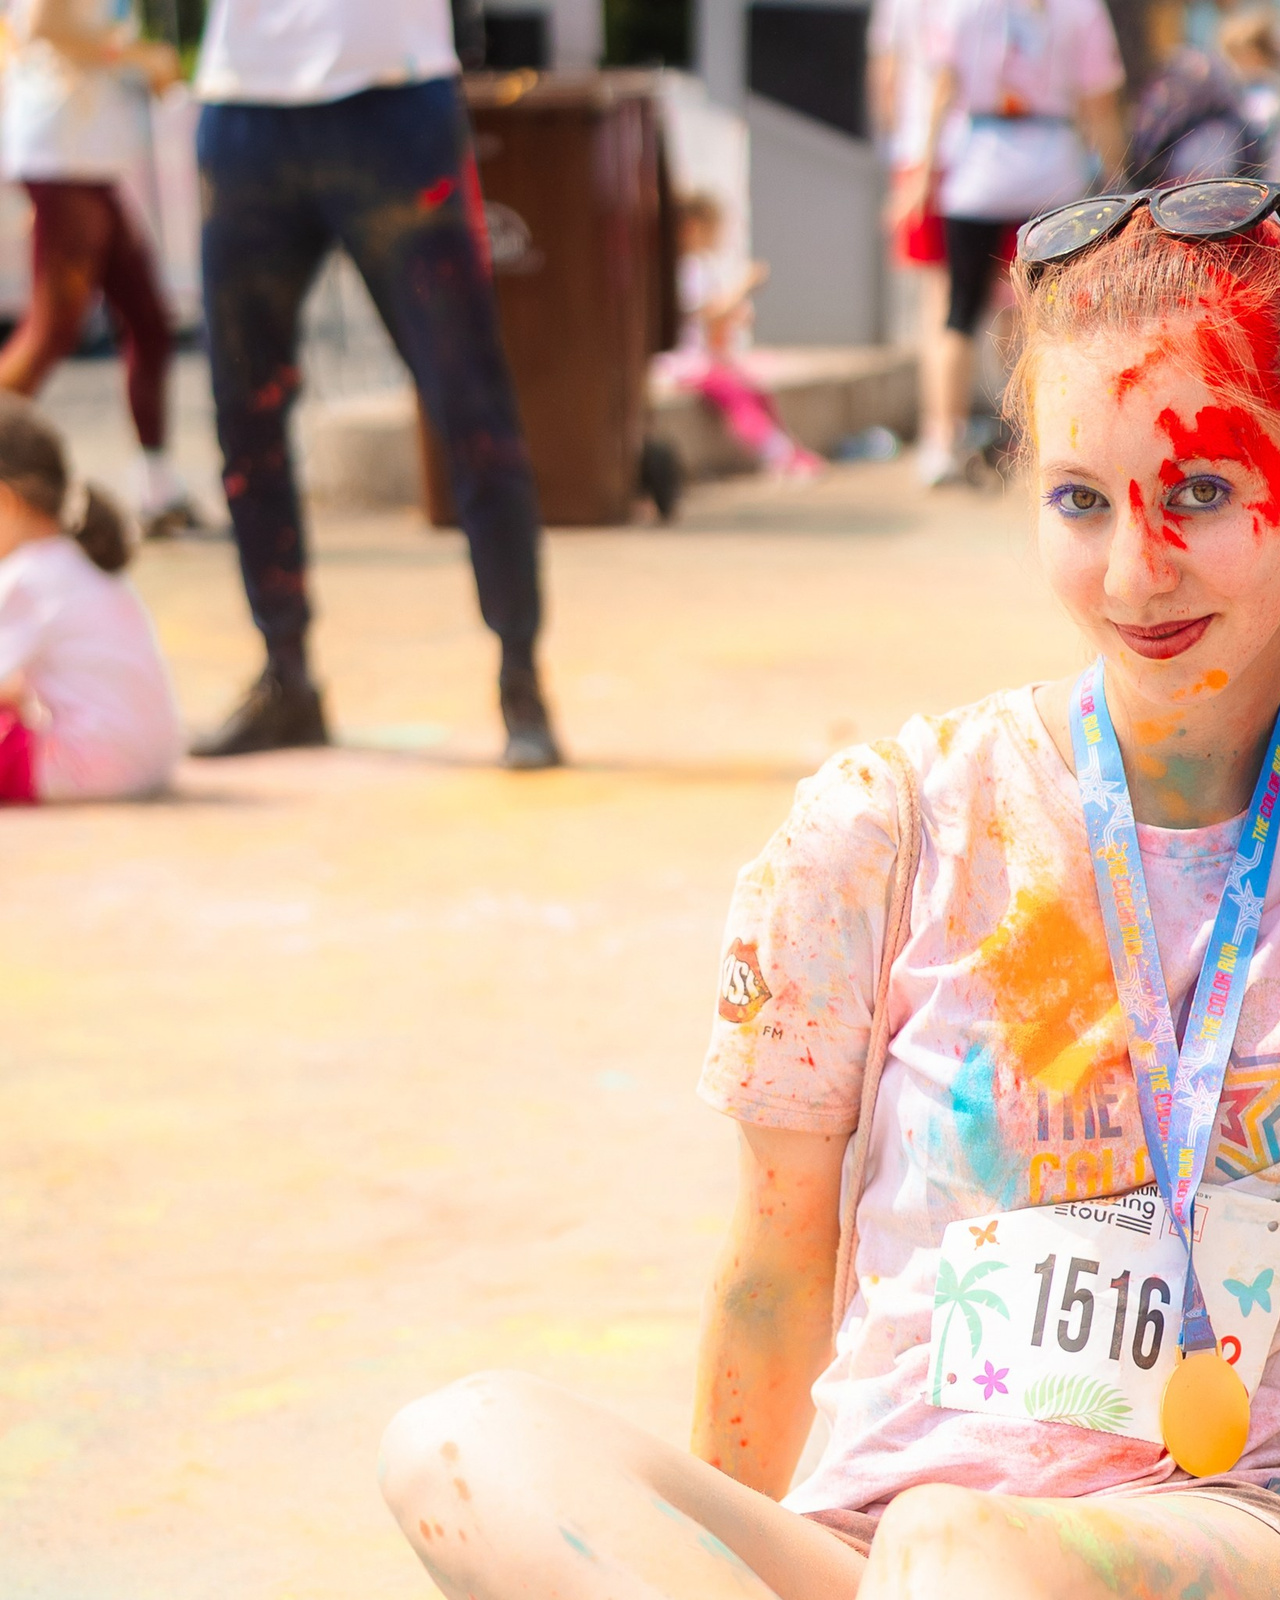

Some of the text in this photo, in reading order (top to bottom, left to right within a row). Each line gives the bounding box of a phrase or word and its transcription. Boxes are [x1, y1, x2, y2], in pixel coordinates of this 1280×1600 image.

[1082, 714, 1103, 745] RUN
[1252, 815, 1270, 843] THE
[1121, 925, 1145, 955] RUN
[1200, 942, 1239, 1041] THE COLOR RUN
[762, 1025, 784, 1041] FM
[1148, 1065, 1171, 1093] THE
[1178, 1148, 1195, 1177] RUN
[1070, 1204, 1116, 1225] tour
[1030, 1252, 1171, 1370] 1516
